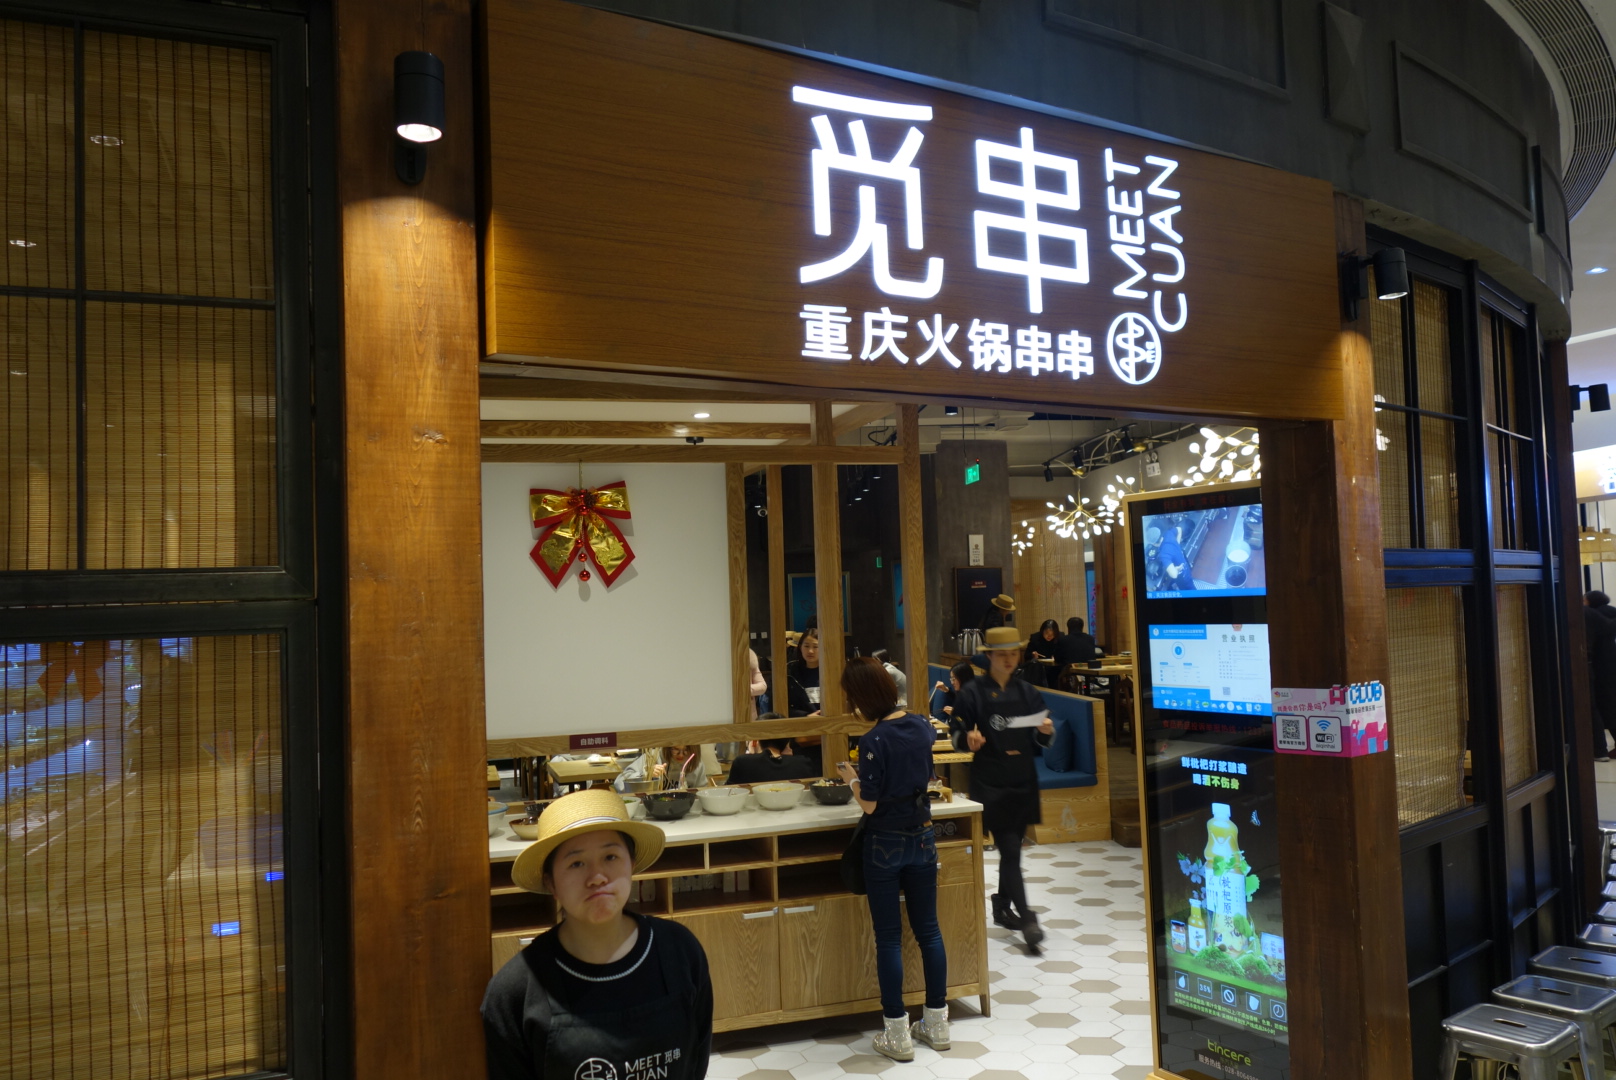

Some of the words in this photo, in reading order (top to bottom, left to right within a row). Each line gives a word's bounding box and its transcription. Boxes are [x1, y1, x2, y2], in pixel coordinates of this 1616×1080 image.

[793, 85, 1089, 313] 觅串
[1105, 148, 1148, 299] MEET
[1145, 155, 1188, 332] CUAN
[800, 304, 1094, 380] 重庆火锅串串
[1221, 634, 1256, 643] 营业执照
[1349, 680, 1382, 705] CLUB
[580, 736, 609, 746] 自助调料
[1221, 876, 1234, 928] 枇杷原浆
[624, 1053, 662, 1074] MEET
[664, 1048, 681, 1064] 觅串
[1207, 1038, 1252, 1067] tincere
